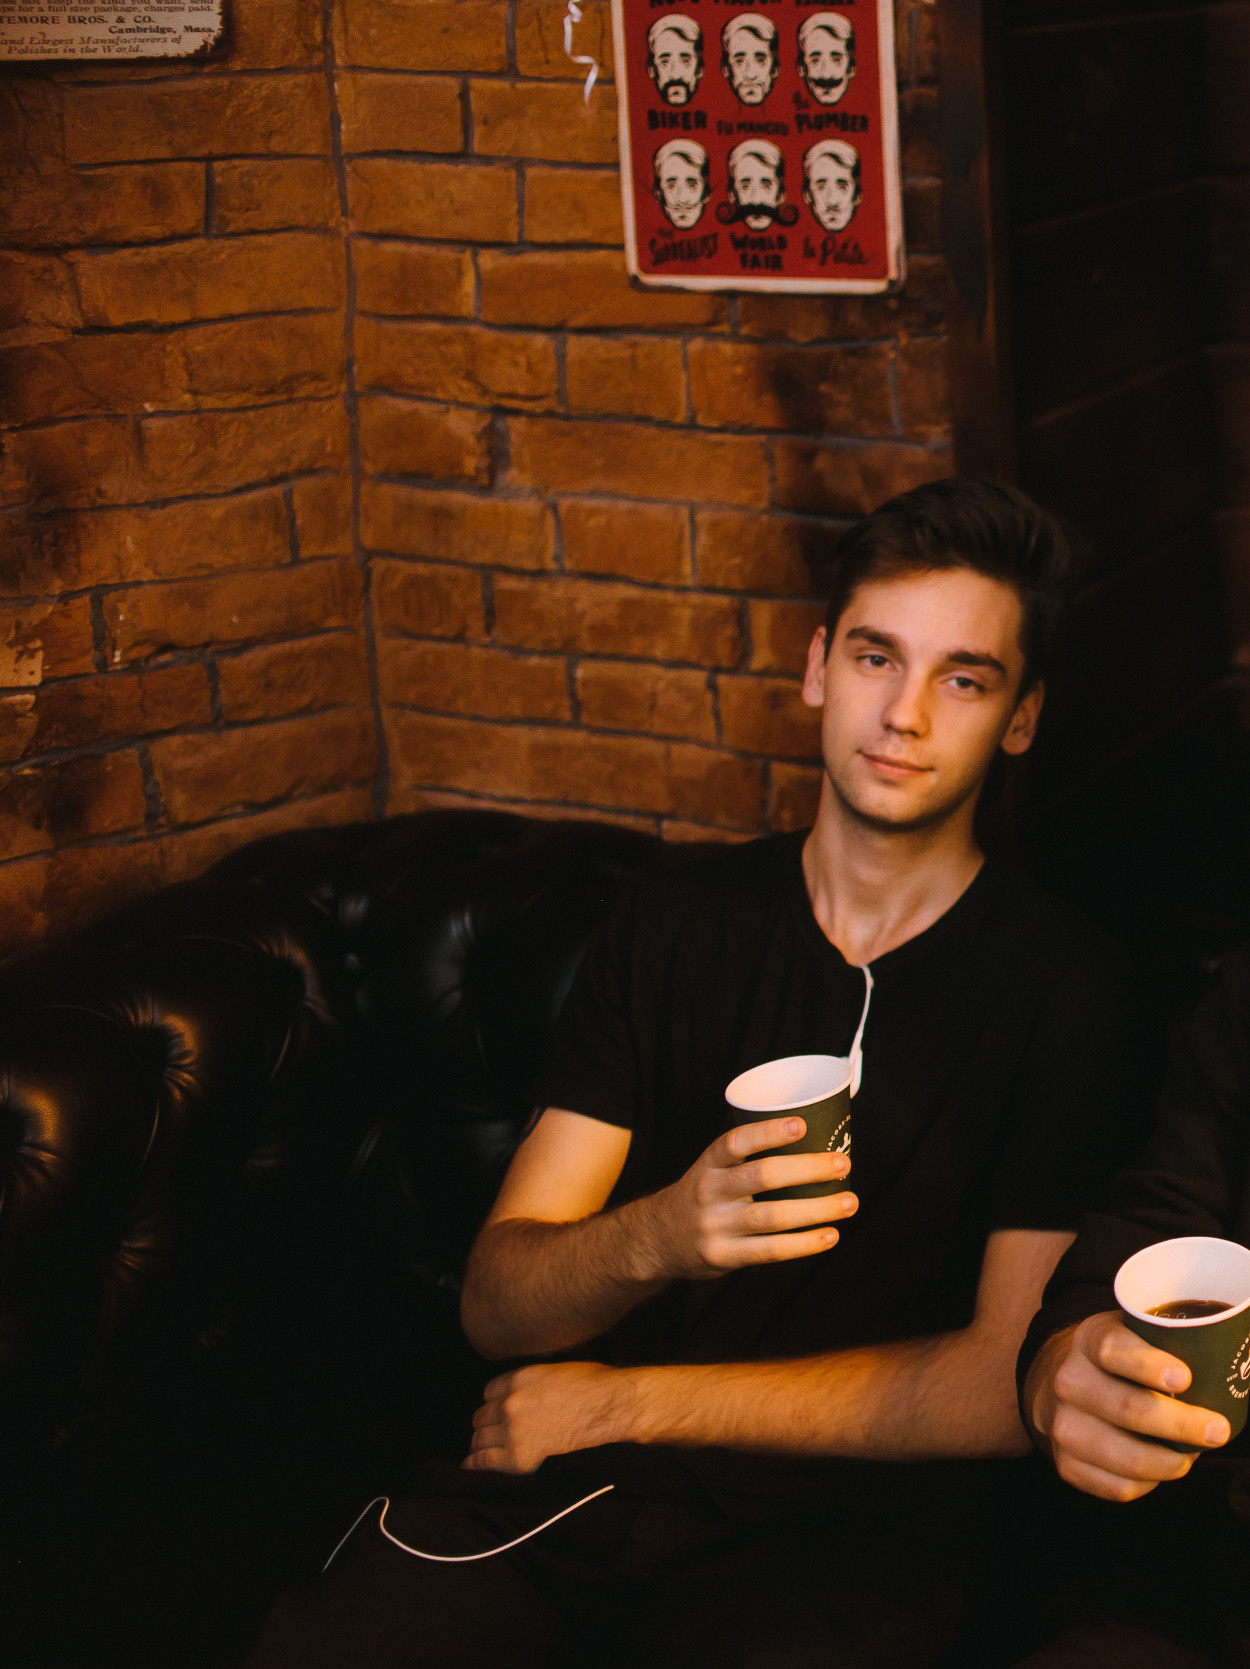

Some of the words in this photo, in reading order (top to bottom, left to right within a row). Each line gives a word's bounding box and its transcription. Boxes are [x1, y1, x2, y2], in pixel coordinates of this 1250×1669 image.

[67, 15, 108, 25] BROS.
[115, 15, 126, 23] &
[133, 15, 155, 23] CO.
[108, 25, 176, 34] Cambridge,
[647, 109, 707, 131] BIKER
[729, 231, 788, 252] WORLD
[739, 251, 784, 272] FAIR
